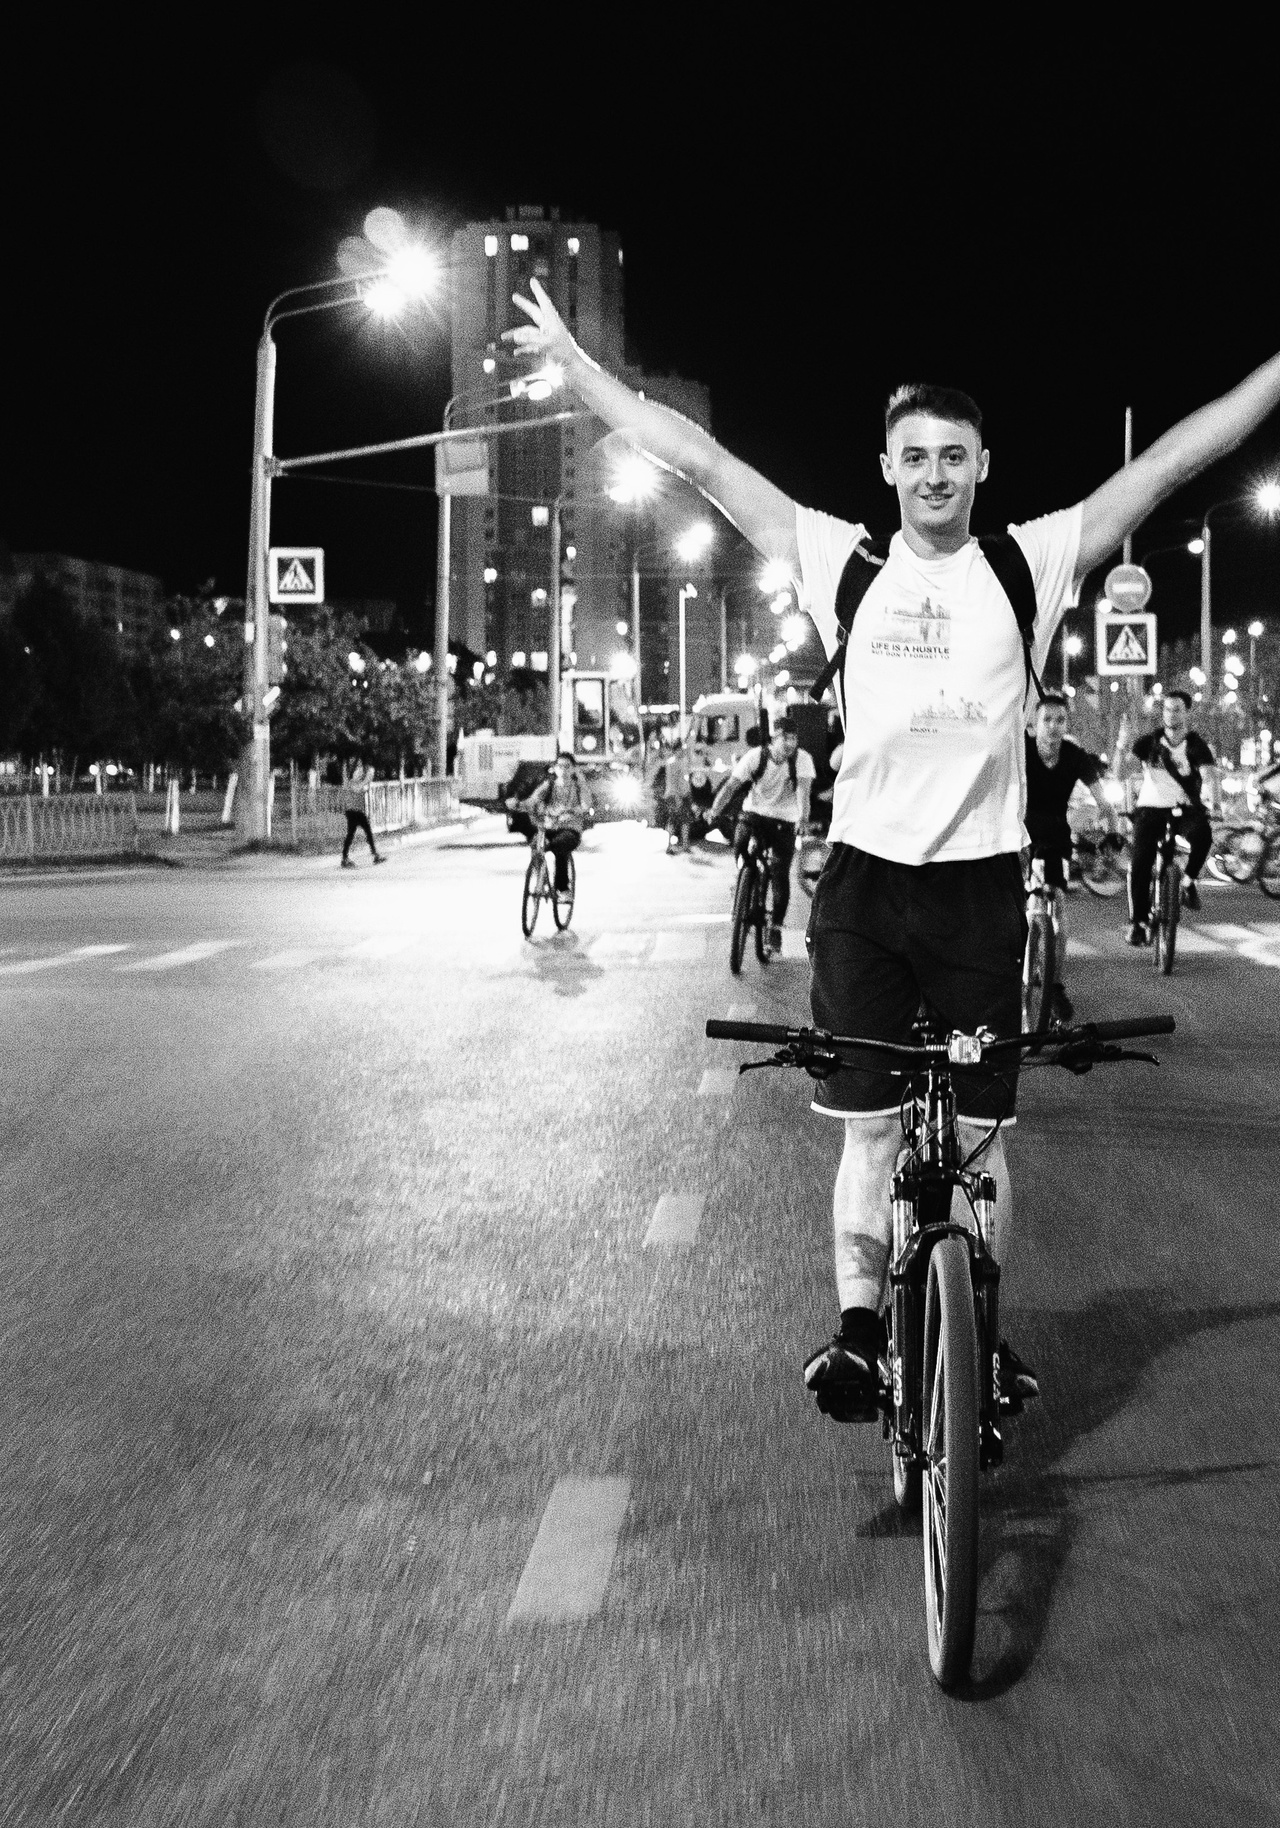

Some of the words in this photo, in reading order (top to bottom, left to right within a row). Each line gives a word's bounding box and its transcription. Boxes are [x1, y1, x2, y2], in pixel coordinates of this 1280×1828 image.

[871, 641, 889, 650] LIFE
[892, 643, 901, 652] IS
[903, 645, 910, 653] A
[912, 645, 949, 654] HUSTLE
